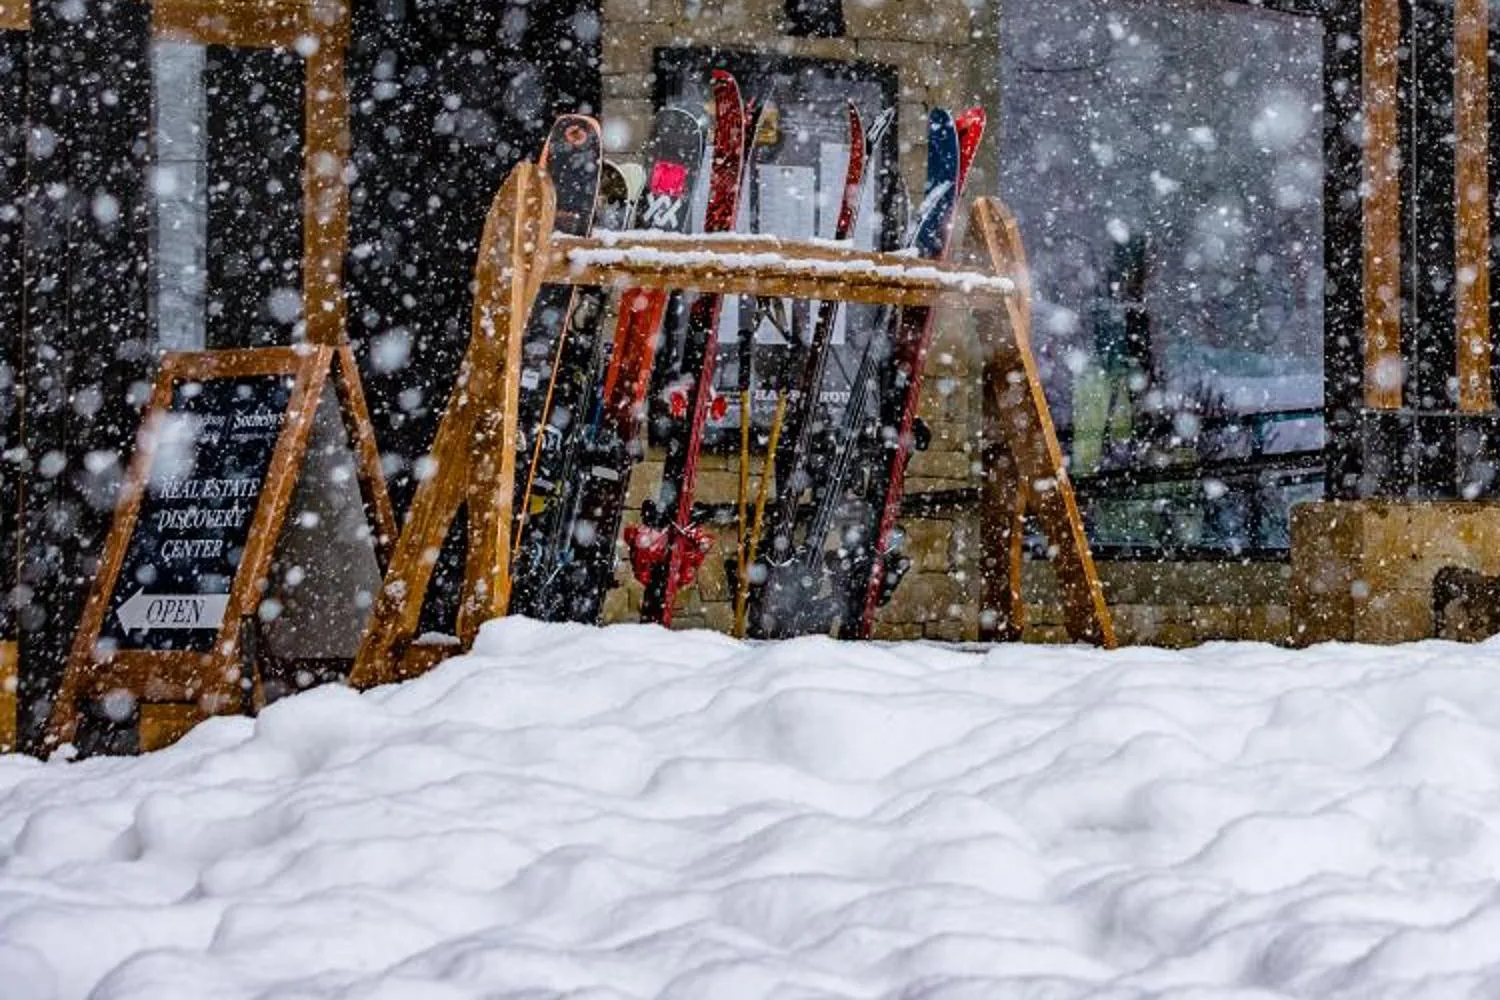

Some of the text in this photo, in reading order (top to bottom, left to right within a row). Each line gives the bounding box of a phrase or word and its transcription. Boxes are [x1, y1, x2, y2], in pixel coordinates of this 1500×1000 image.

[159, 477, 261, 500] REAL ESTATE
[157, 506, 247, 530] DISCOVERY
[160, 539, 224, 560] CENTER
[146, 598, 205, 624] OPEN
